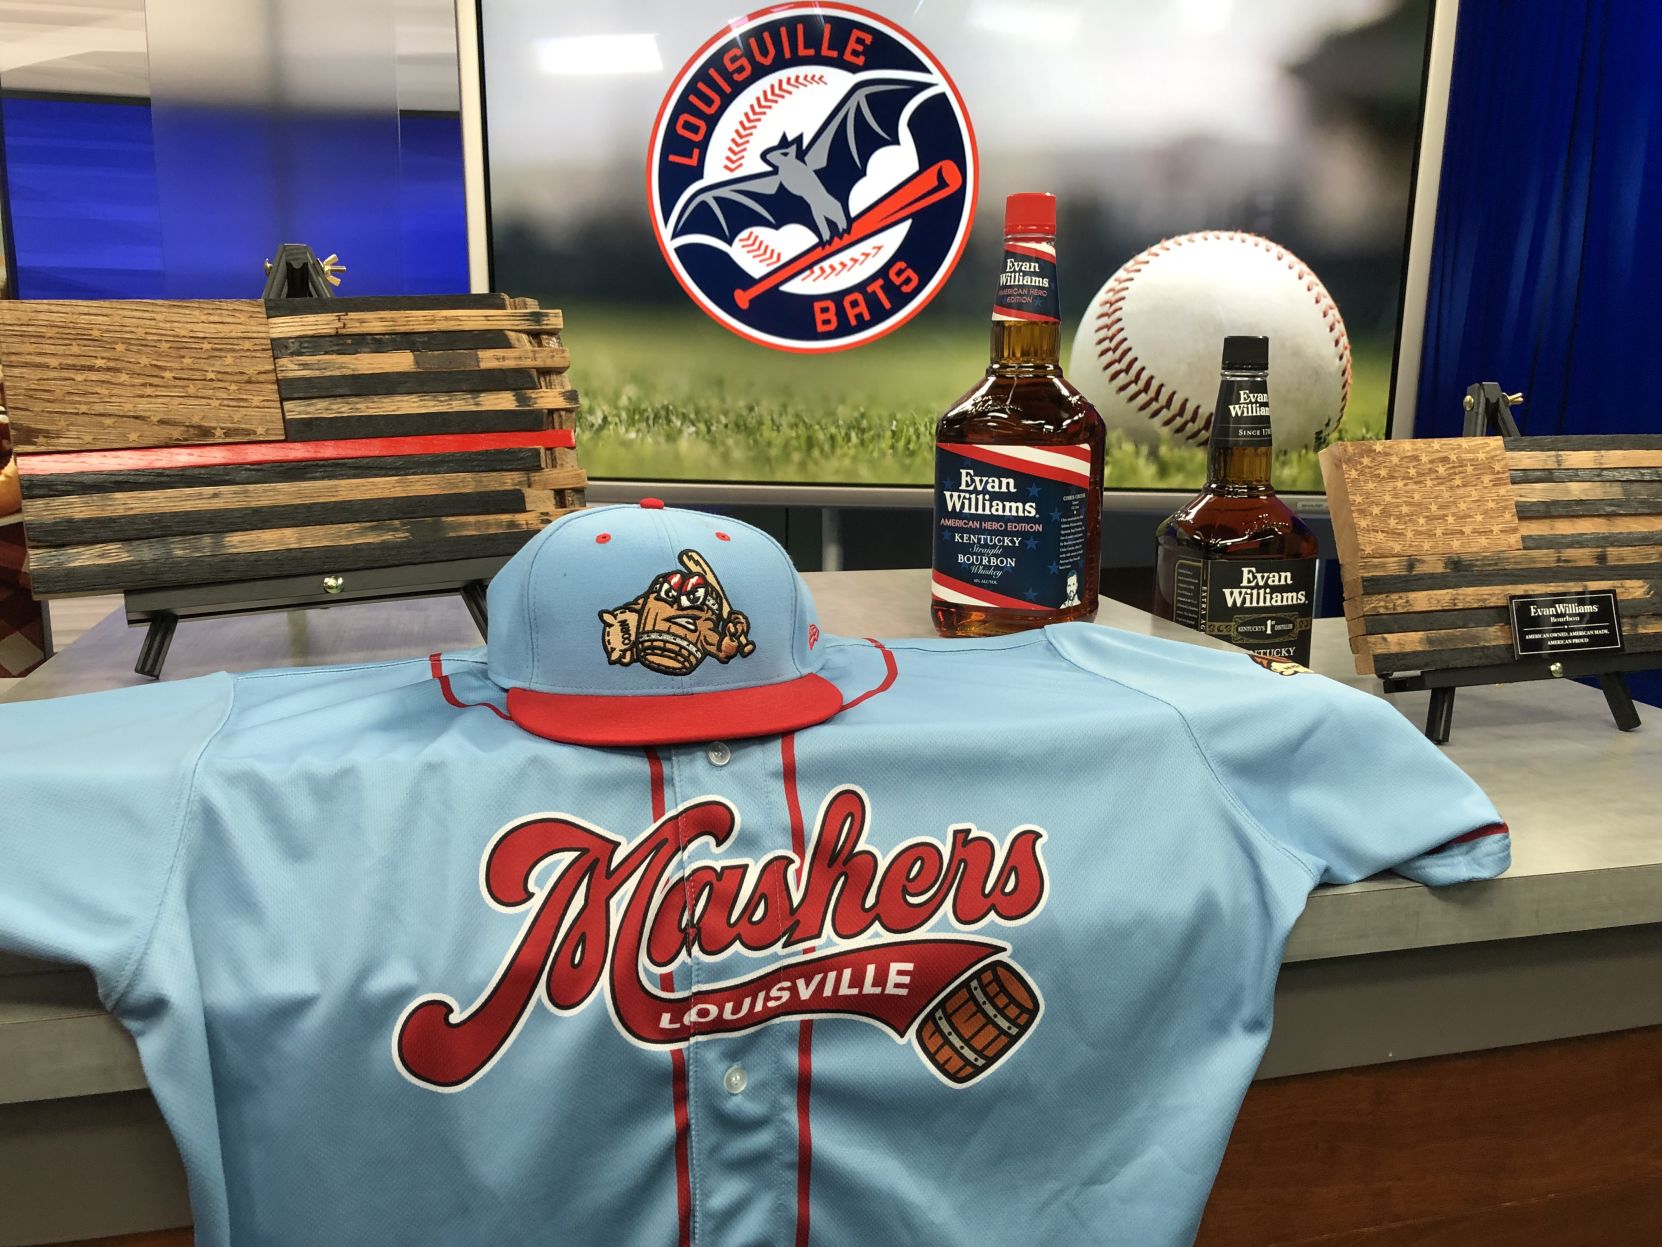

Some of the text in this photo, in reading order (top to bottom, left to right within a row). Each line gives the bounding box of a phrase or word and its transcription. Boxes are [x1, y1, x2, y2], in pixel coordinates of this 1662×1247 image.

[668, 23, 873, 167] LOUISVILLE
[1006, 258, 1040, 272] Evan
[1000, 273, 1049, 287] Williams
[813, 261, 919, 333] BATS
[1030, 289, 1048, 297] HERO
[959, 468, 1016, 492] Evan
[944, 491, 1036, 517] Williams
[940, 518, 1043, 532] AMERICAN HERO EDITION
[954, 533, 1022, 547] KENTUCKY
[969, 543, 1002, 557] Straight
[957, 554, 1016, 567] BOURBON
[970, 566, 1002, 578] Whiskey
[1240, 567, 1293, 587] Evan
[1222, 588, 1306, 608] Williams
[1550, 615, 1580, 623] Bourbon
[617, 619, 631, 646] CORN
[395, 786, 1048, 1090] Mashers
[659, 961, 914, 1030] LOUISVILLE
